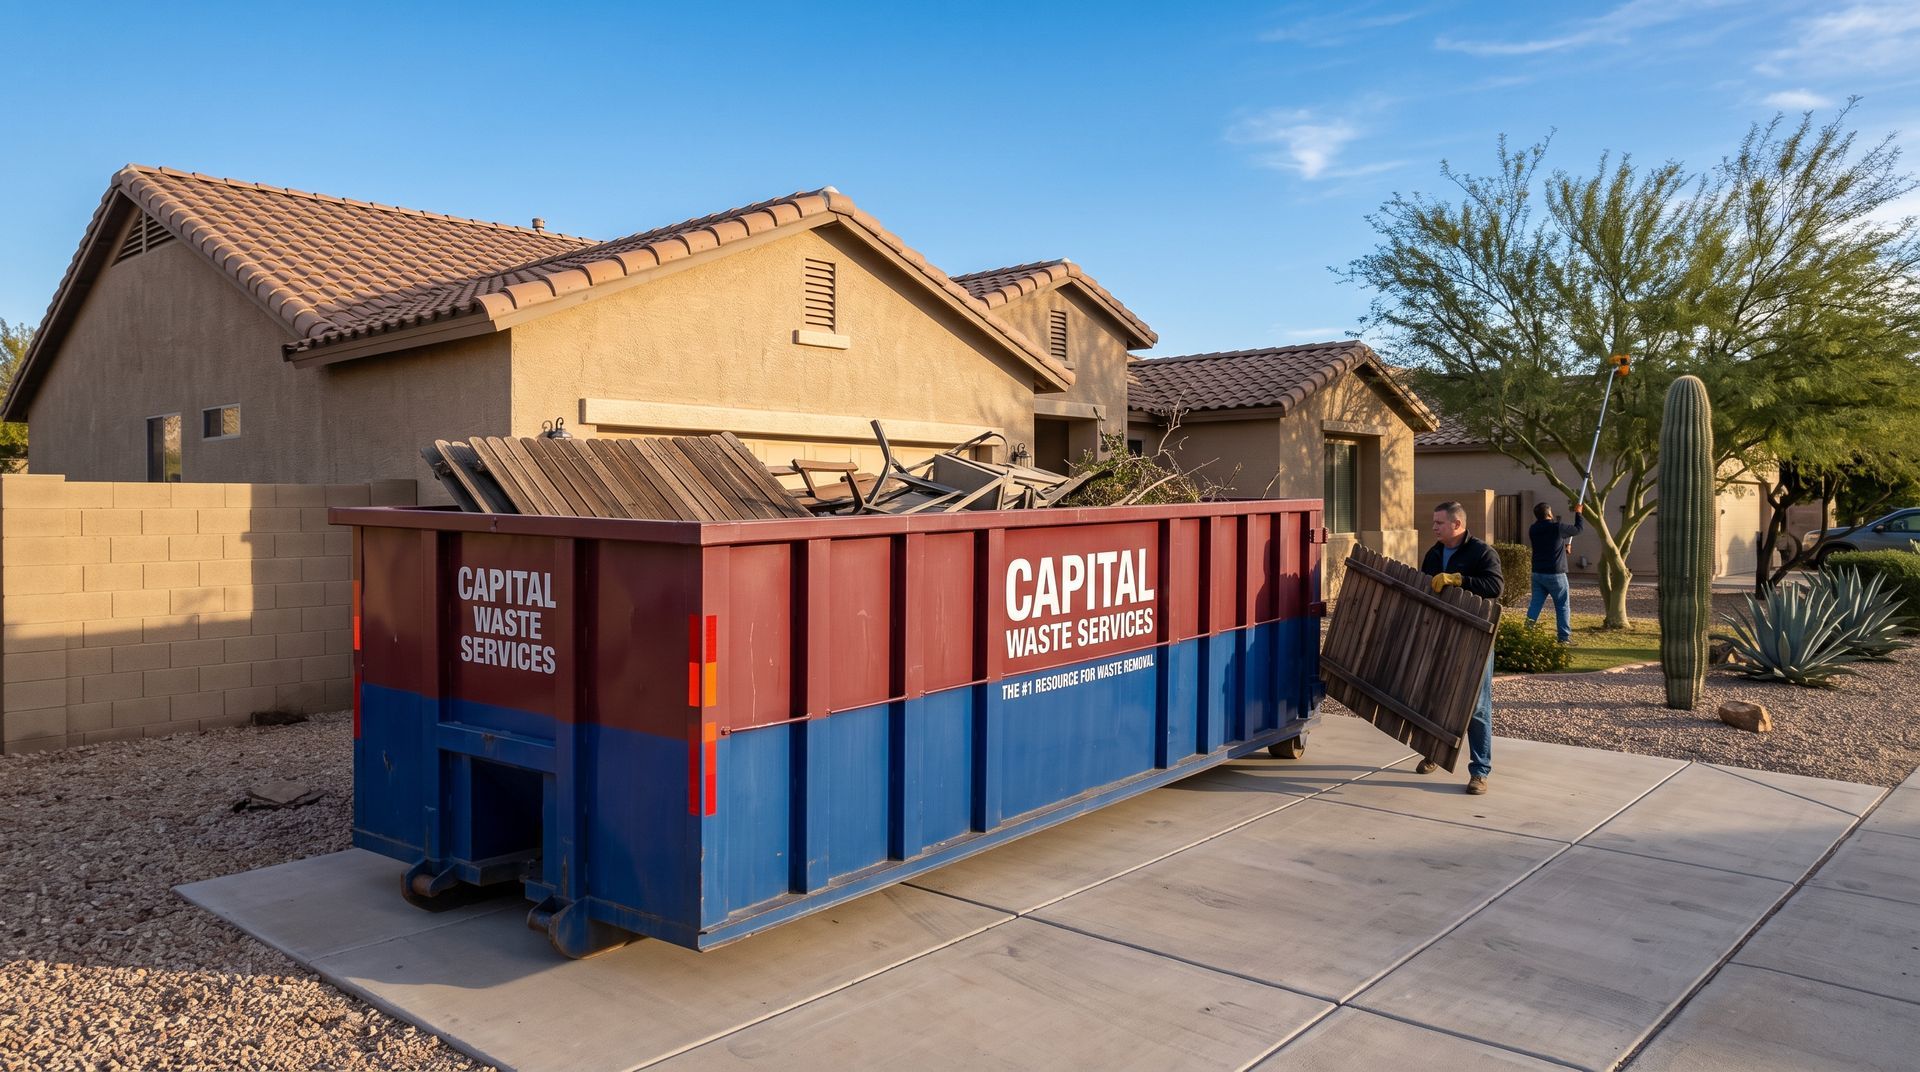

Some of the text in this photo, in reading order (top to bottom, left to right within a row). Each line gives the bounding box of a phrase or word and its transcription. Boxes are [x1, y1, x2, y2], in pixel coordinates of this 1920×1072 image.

[457, 566, 557, 609] CAPITAL
[1006, 548, 1155, 622] CAPITAL
[473, 605, 542, 640] WASTE
[1005, 607, 1153, 659] WASTE SERVICES
[460, 635, 556, 675] SERVICES
[1002, 654, 1154, 700] THE #1 RESOURCE FOR WASTE REMOVAL
